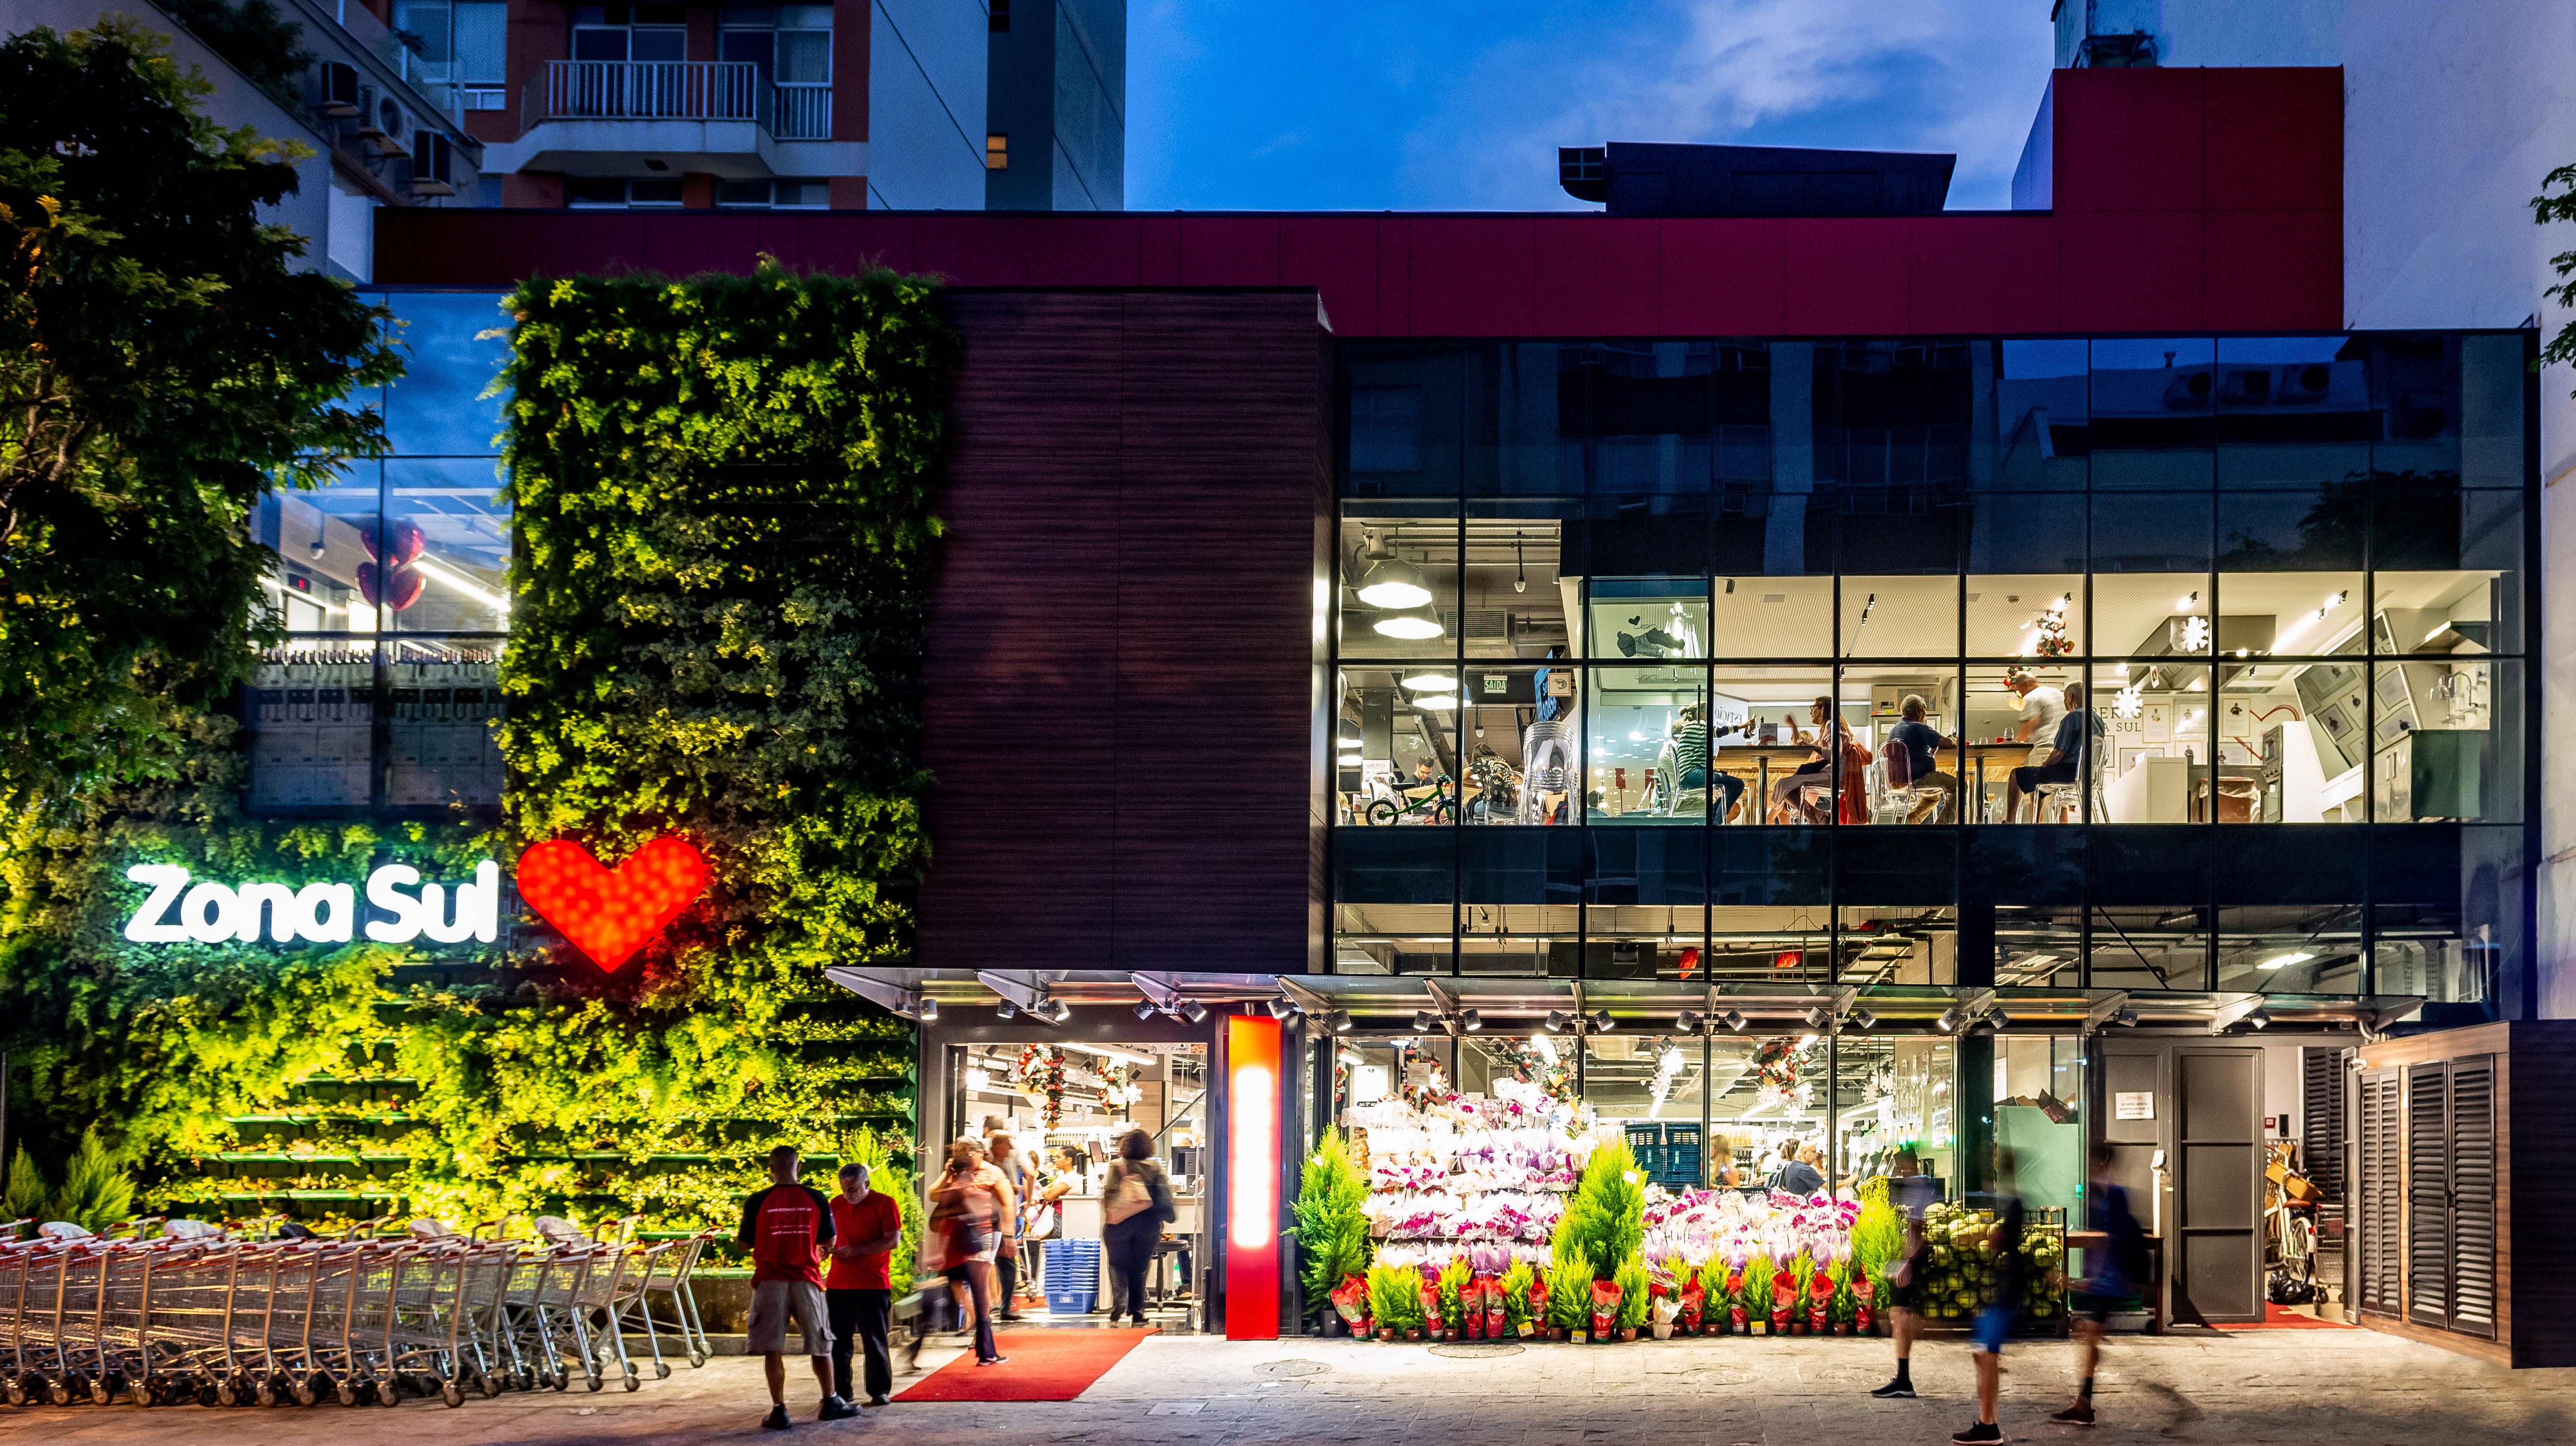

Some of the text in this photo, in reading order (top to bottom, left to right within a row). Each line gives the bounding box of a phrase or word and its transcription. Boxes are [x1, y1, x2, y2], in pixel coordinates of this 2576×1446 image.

[2116, 722, 2141, 732] SUL
[124, 860, 499, 943] Zona Sul
